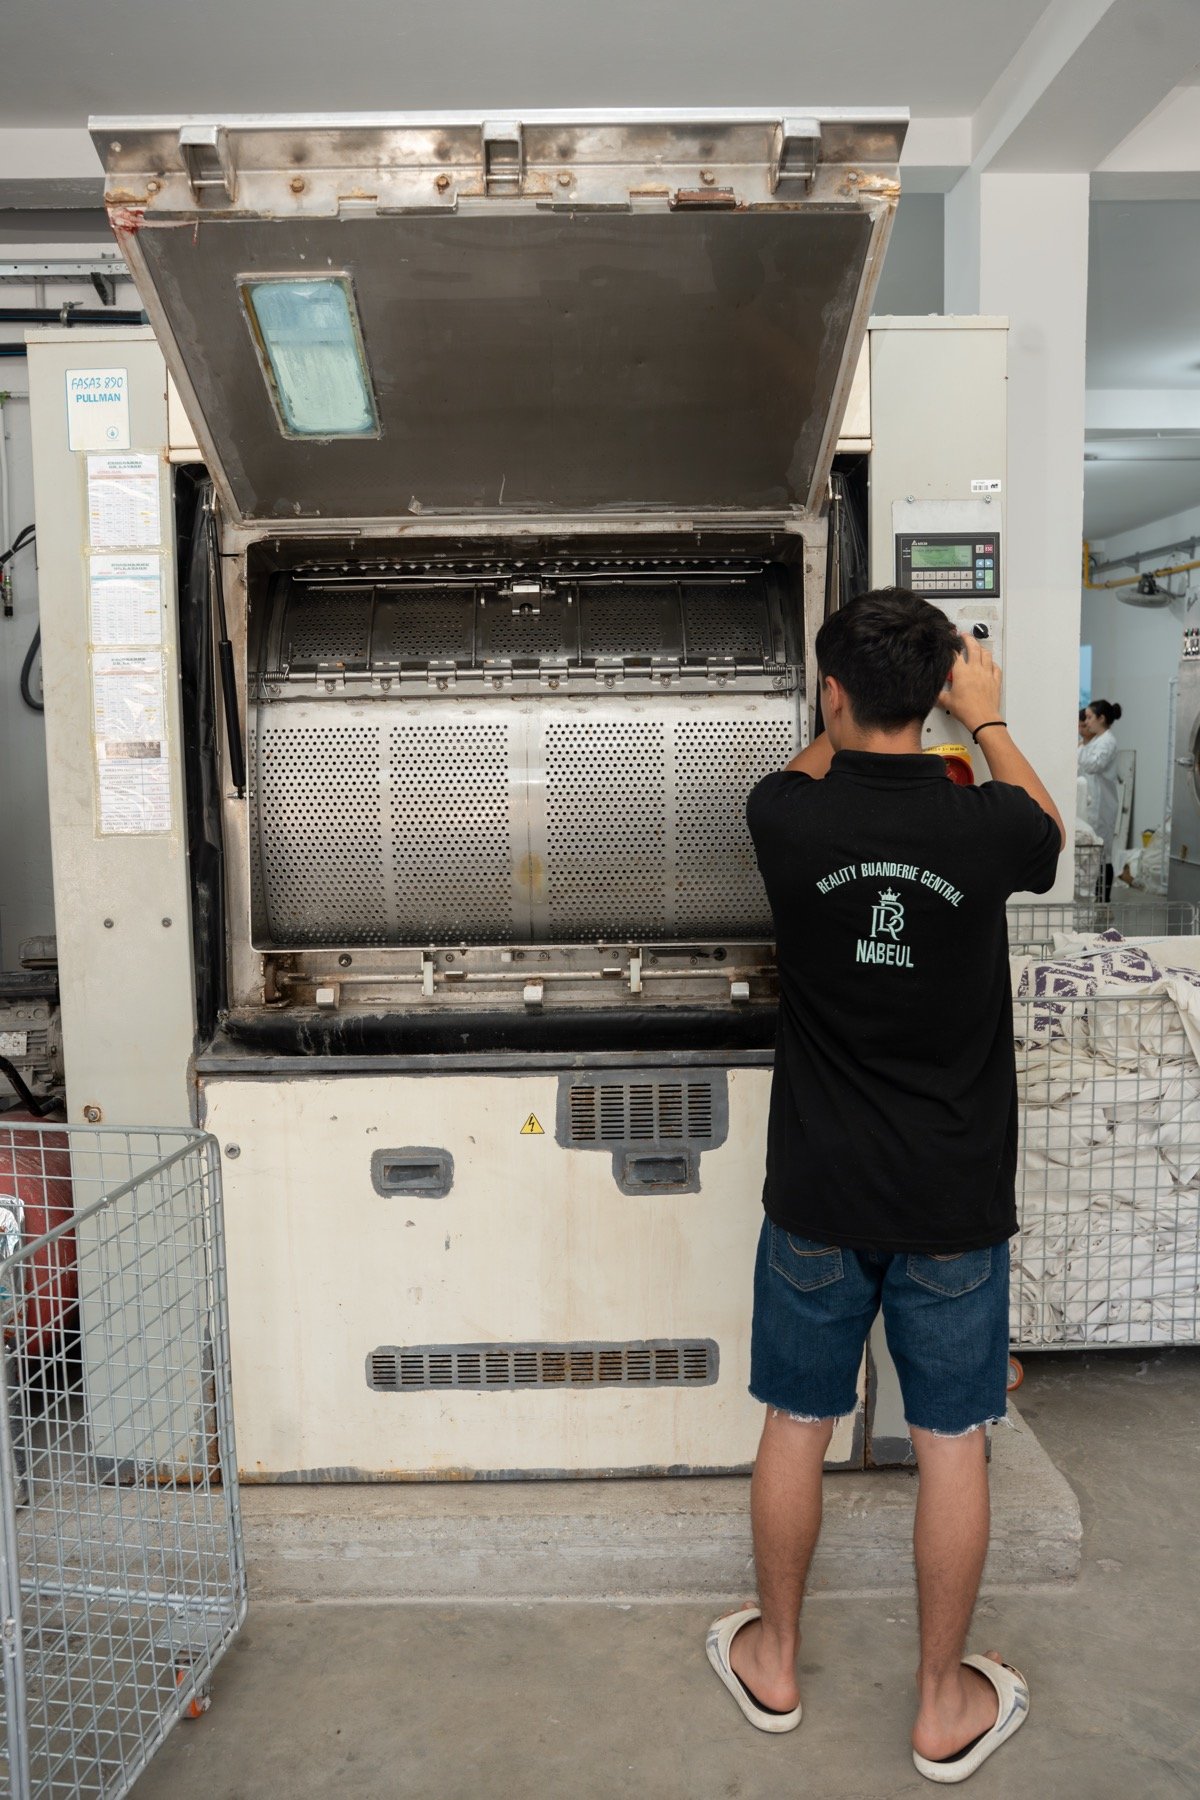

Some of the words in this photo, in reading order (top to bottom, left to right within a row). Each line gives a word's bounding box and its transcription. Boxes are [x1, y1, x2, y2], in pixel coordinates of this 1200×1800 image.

[104, 377, 123, 389] 890
[76, 393, 121, 403] PULLMAN
[816, 865, 857, 895] REALITY
[861, 862, 920, 881] BUANDERIE
[920, 870, 965, 907] CENTRAL
[856, 939, 914, 968] NABEUL
